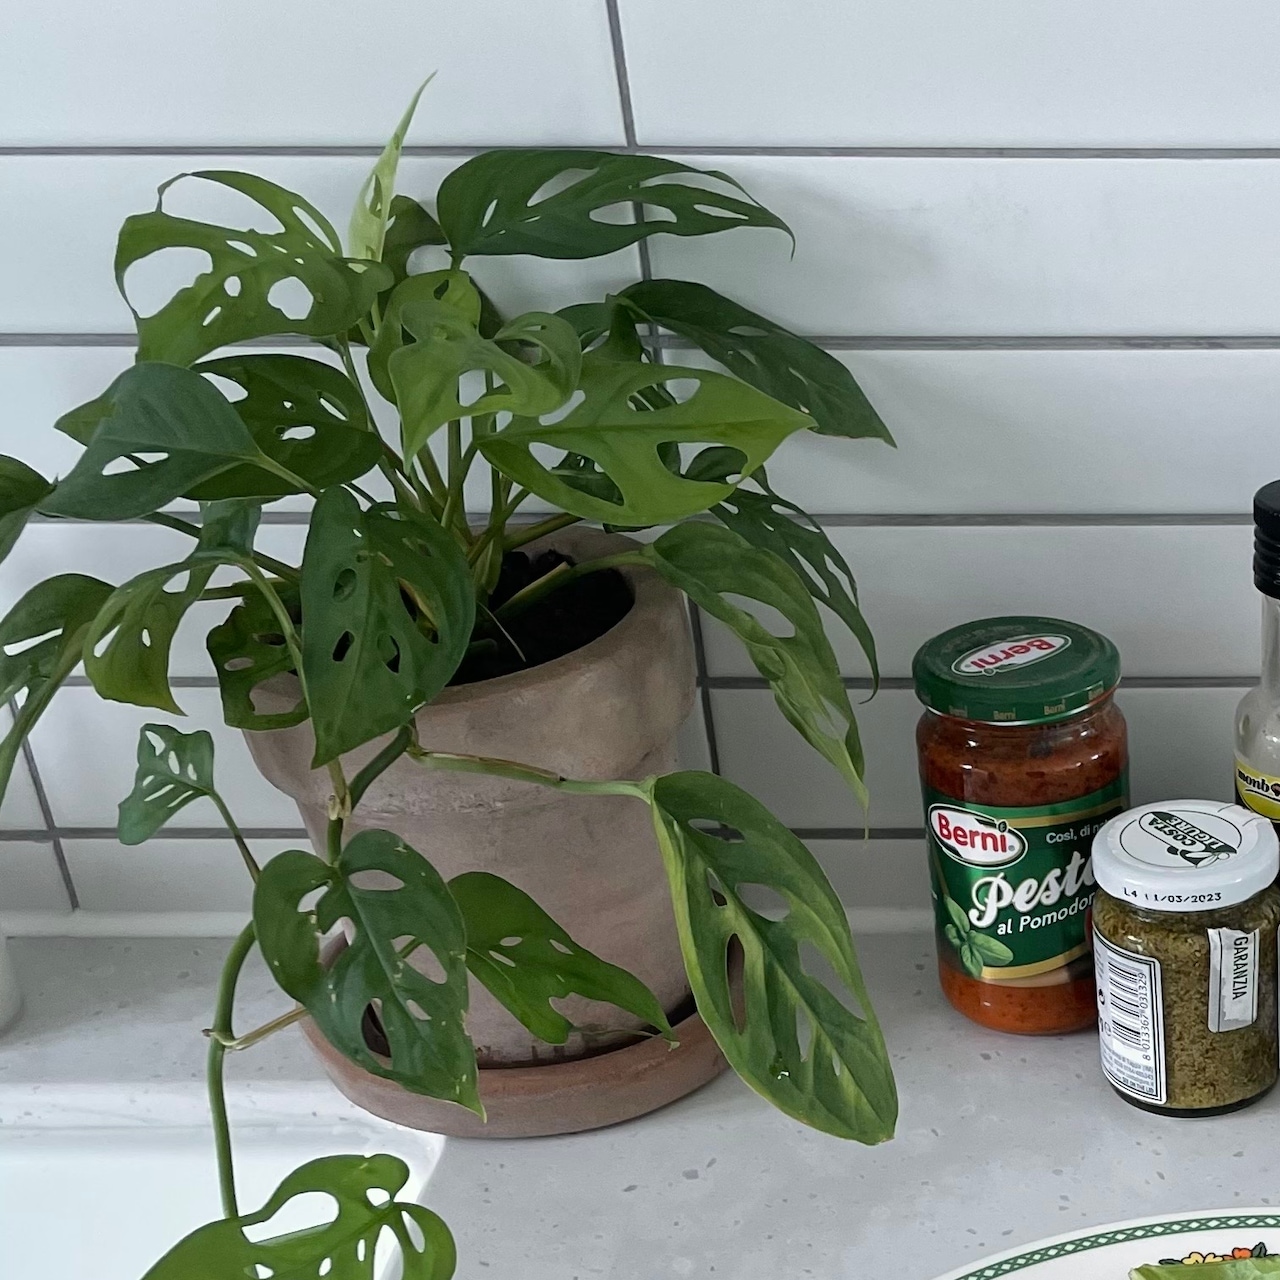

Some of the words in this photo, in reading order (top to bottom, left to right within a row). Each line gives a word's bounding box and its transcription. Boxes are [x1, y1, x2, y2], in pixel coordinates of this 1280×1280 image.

[971, 638, 1056, 669] Berni
[937, 812, 1008, 853] Berni
[1147, 816, 1197, 847] COSTA
[1168, 815, 1225, 850] LIGURE
[997, 920, 1012, 936] al
[1019, 891, 1096, 933] Pomodor
[1232, 936, 1249, 1000] GARANZIA
